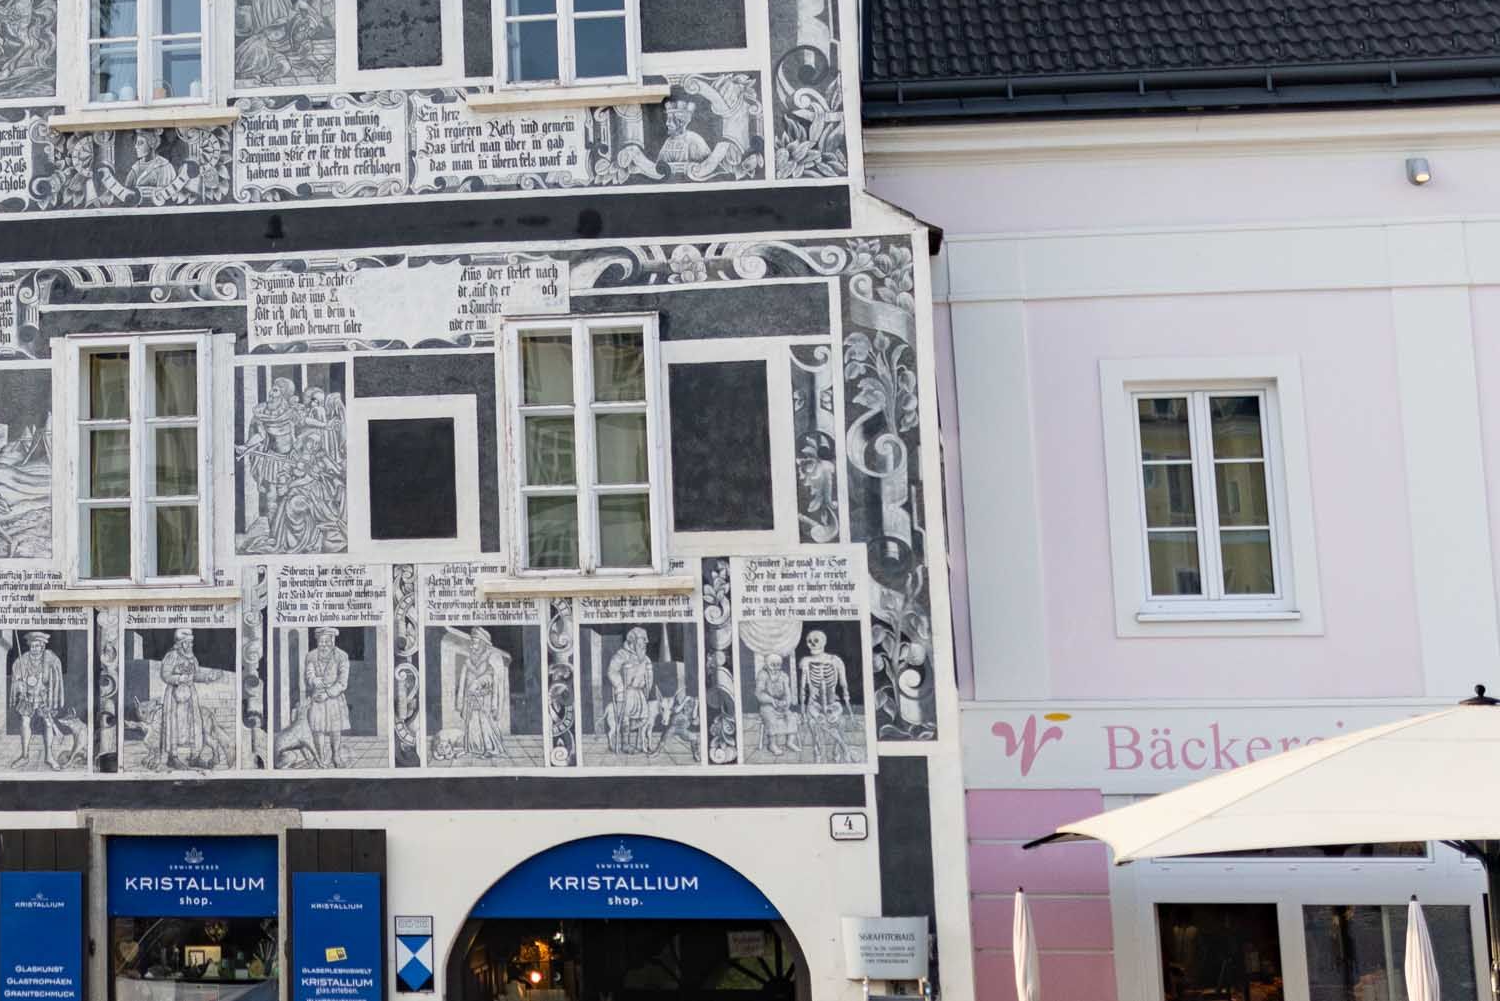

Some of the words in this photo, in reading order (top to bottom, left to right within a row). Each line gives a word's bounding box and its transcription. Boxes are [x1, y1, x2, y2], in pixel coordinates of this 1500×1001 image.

[1106, 720, 1343, 770] Bäcker
[843, 816, 852, 830] 4
[125, 877, 265, 890] KRISTALLIUM
[548, 876, 699, 891] KRISTALLIUM
[179, 896, 212, 905] shop.
[607, 895, 644, 906] shop.
[301, 978, 372, 987] KRISTALLIUM
[4, 990, 75, 998] GRANITSCHMUCK
